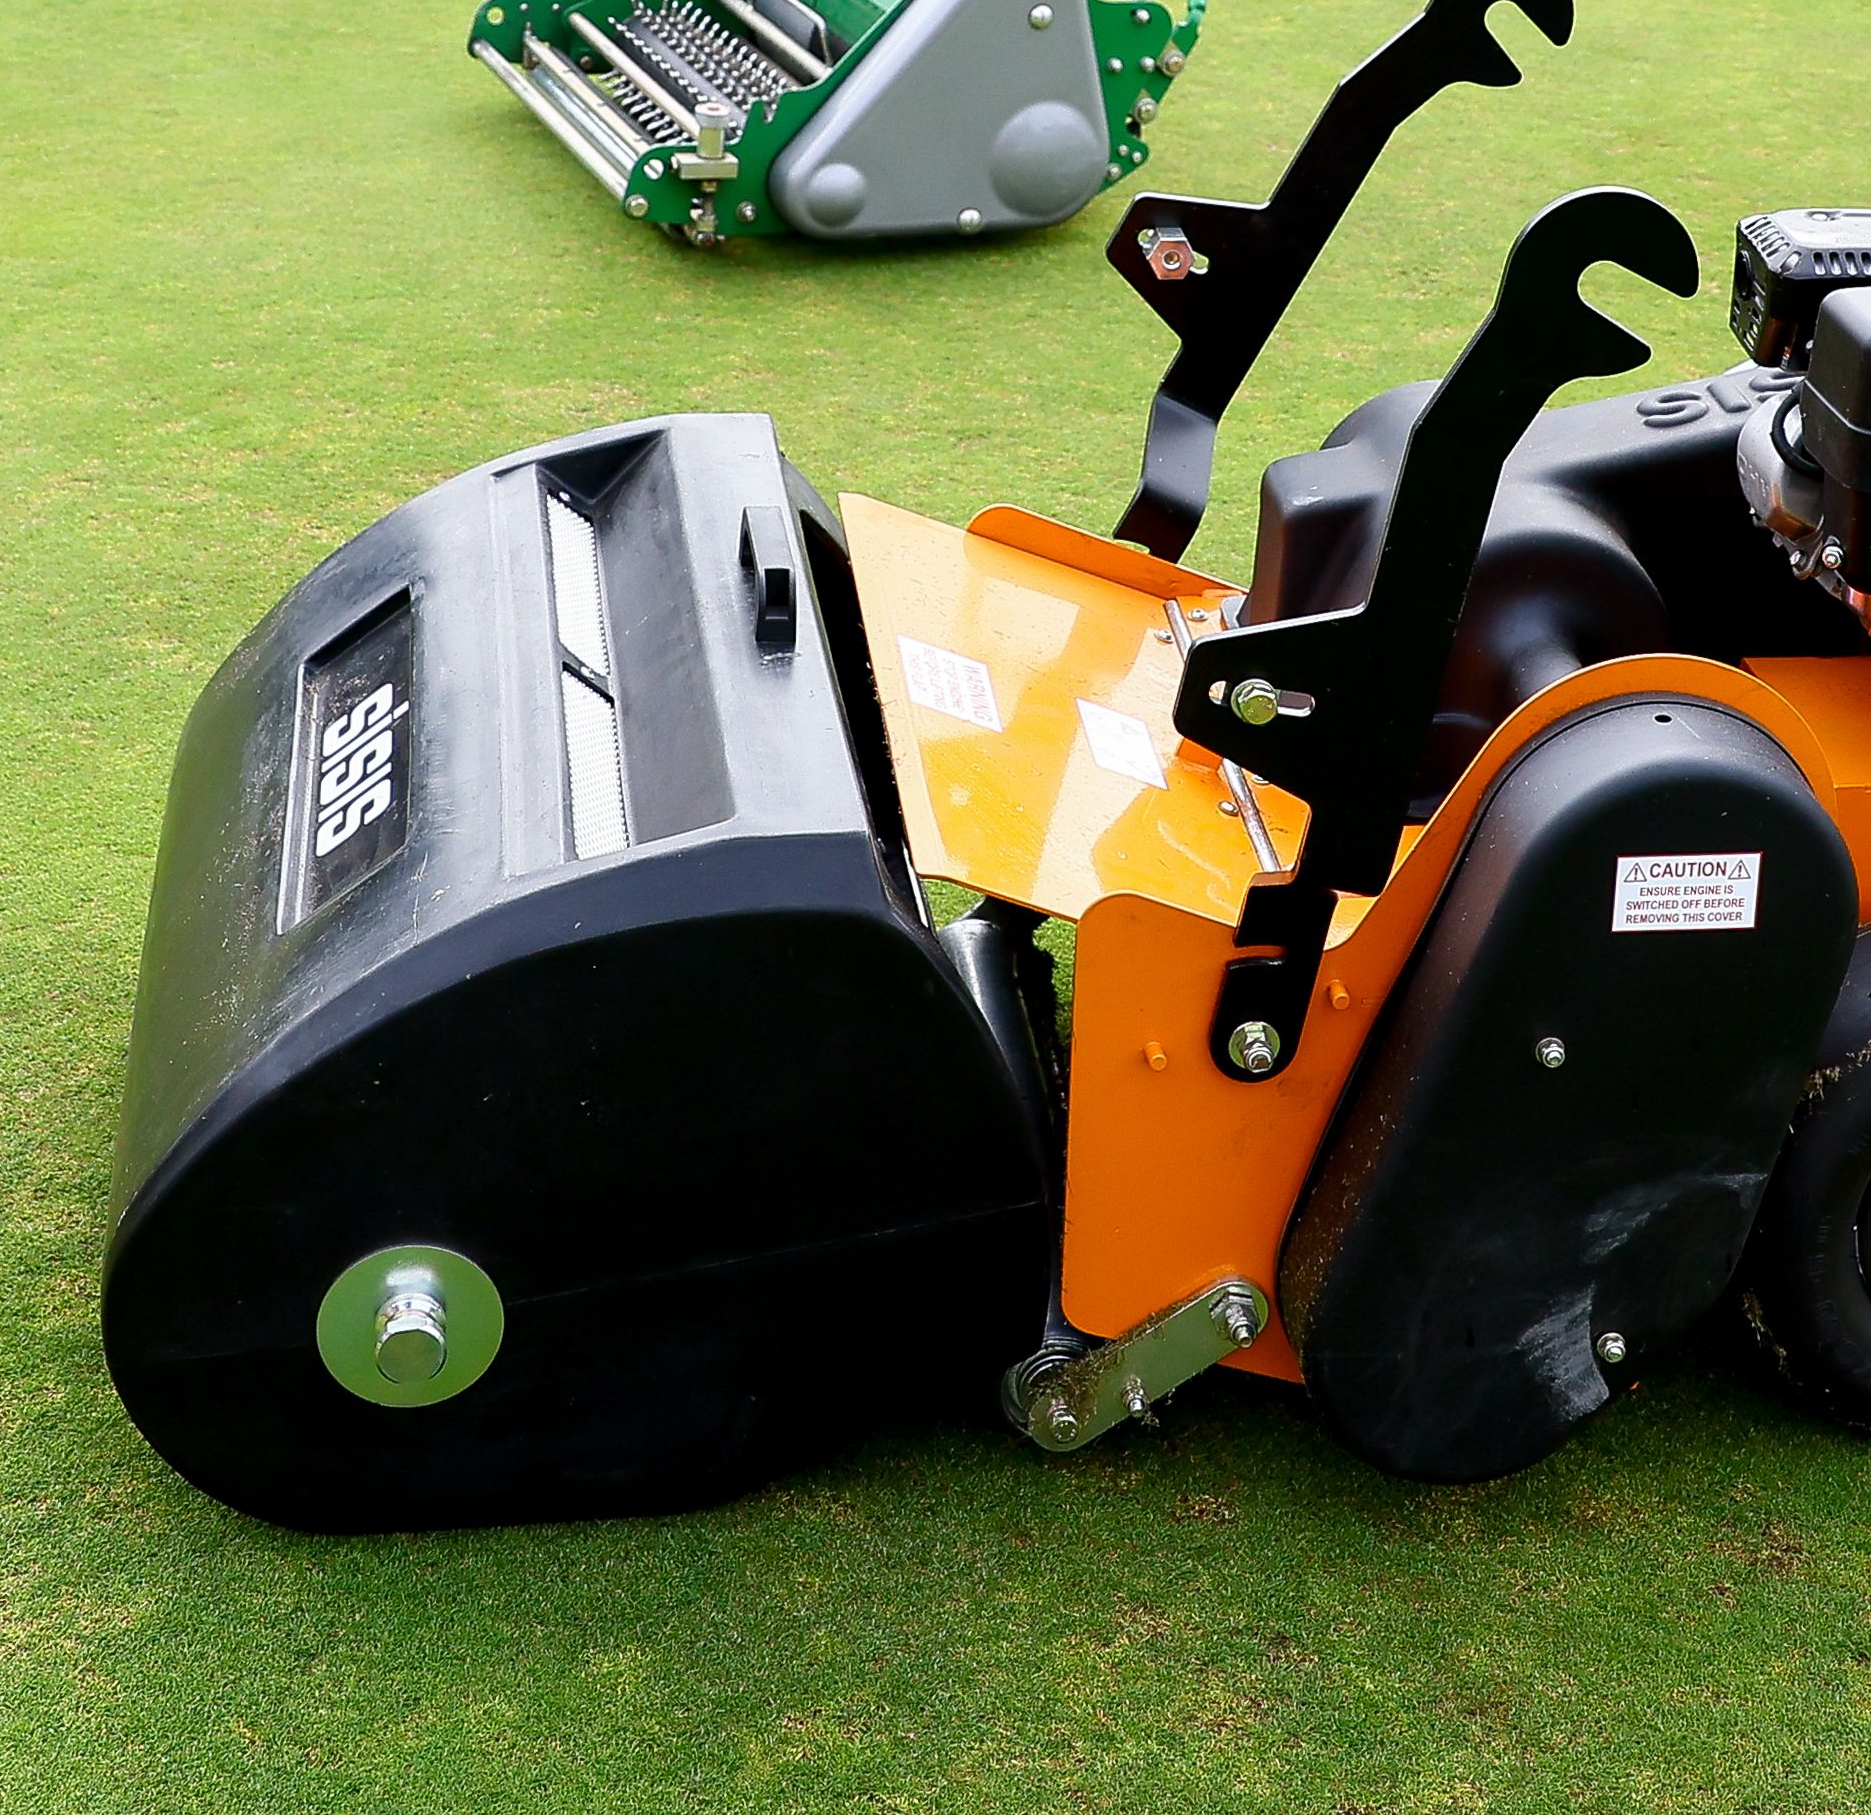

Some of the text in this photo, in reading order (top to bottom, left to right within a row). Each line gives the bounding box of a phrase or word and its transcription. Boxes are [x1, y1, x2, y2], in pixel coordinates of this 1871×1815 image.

[963, 664, 993, 722] WARNING
[1649, 861, 1727, 878] CAUTION
[1639, 885, 1734, 897] ENSURE ENGINE IS
[1626, 898, 1745, 910] SWITCHED OFF BEFORE
[1625, 911, 1743, 924] REMOVING THIS COVER
